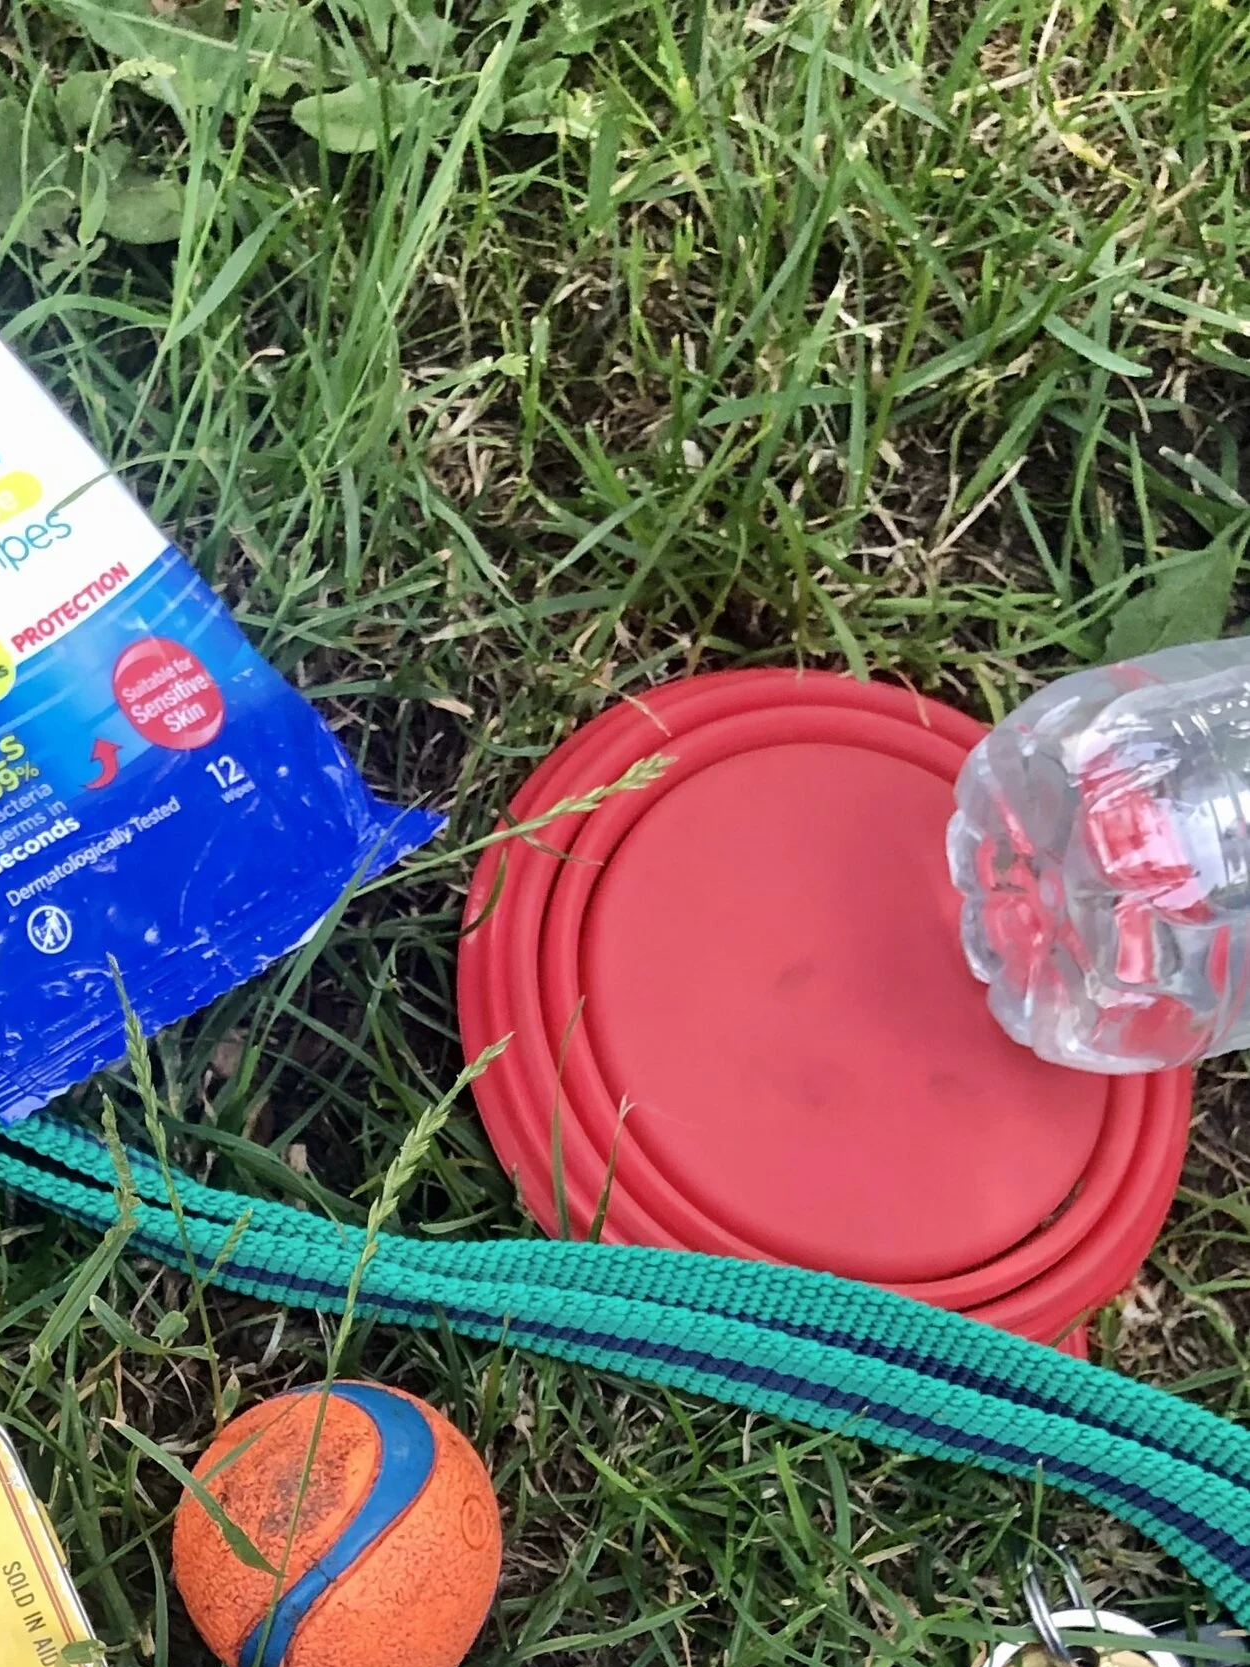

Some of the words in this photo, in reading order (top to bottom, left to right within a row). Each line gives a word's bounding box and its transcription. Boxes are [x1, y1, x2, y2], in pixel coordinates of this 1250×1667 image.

[10, 561, 139, 654] PROTECTION
[121, 665, 179, 703] Suitable
[172, 657, 193, 674] for
[130, 674, 209, 725] Sensitive
[163, 703, 207, 733] Skin
[205, 755, 245, 789] 12
[45, 800, 68, 818] in
[220, 780, 256, 804] Wipes
[5, 826, 134, 907] Dermatologically
[130, 795, 181, 832] Tested
[2, 1560, 35, 1608] SOLD
[23, 1611, 46, 1633] IN
[32, 1637, 60, 1667] AID
